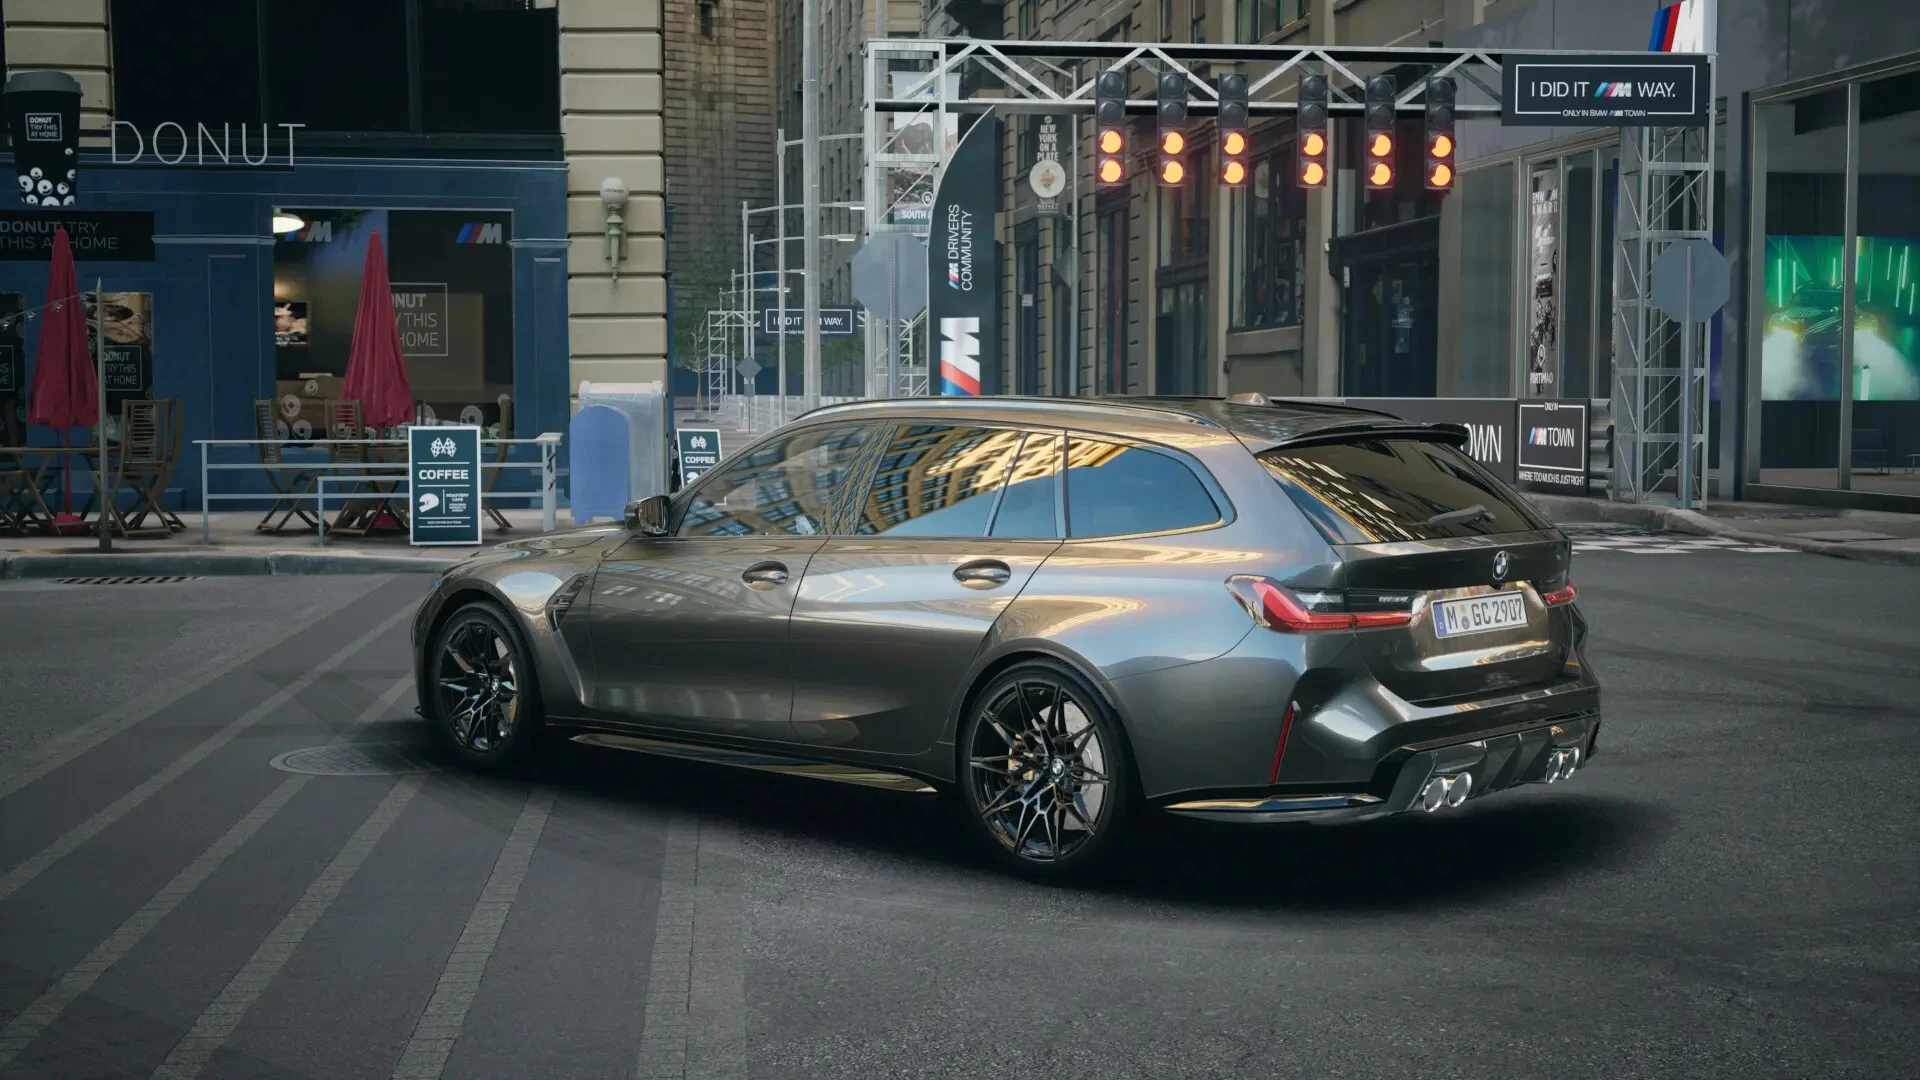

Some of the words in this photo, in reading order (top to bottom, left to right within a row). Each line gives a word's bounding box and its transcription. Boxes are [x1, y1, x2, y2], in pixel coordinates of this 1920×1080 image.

[1531, 81, 1535, 97] I
[1540, 81, 1569, 97] DID
[1573, 81, 1590, 97] IT
[1637, 81, 1676, 98] WAY.
[1562, 109, 1580, 117] ONLY
[1581, 109, 1589, 117] IN
[1589, 109, 1608, 117] BMW
[1624, 109, 1646, 117] TOWN
[30, 116, 52, 124] DONUT
[1040, 124, 1056, 134] NEW
[111, 121, 306, 167] DONUT
[1038, 134, 1058, 143] YORK
[1039, 143, 1050, 152] ON
[1051, 143, 1057, 152] A
[1037, 152, 1059, 161] PLATE
[901, 210, 927, 219] SOUTH
[0, 221, 61, 234] DONUT
[65, 221, 100, 234] TRY
[948, 204, 960, 260] DRIVERS
[41, 236, 56, 249] A
[961, 210, 973, 291] COMMUNITY
[391, 293, 427, 308] NUT
[403, 312, 438, 328] THIS
[824, 317, 843, 326] WAY.
[118, 363, 137, 373] THIS
[113, 375, 137, 385] HOME
[1460, 423, 1502, 463] OWN
[1547, 427, 1575, 447] TOWN
[685, 456, 716, 464] COFFEE
[418, 469, 469, 480] COFFEE
[1518, 470, 1533, 481] WHERE
[1533, 471, 1542, 482] TOO
[1542, 472, 1554, 483] MUCH
[1554, 473, 1560, 484] IS
[1560, 474, 1571, 485] JUST
[1571, 475, 1585, 486] RIGHT
[1447, 606, 1458, 630] M
[1471, 602, 1491, 626] GC
[1492, 598, 1523, 623] 2907
